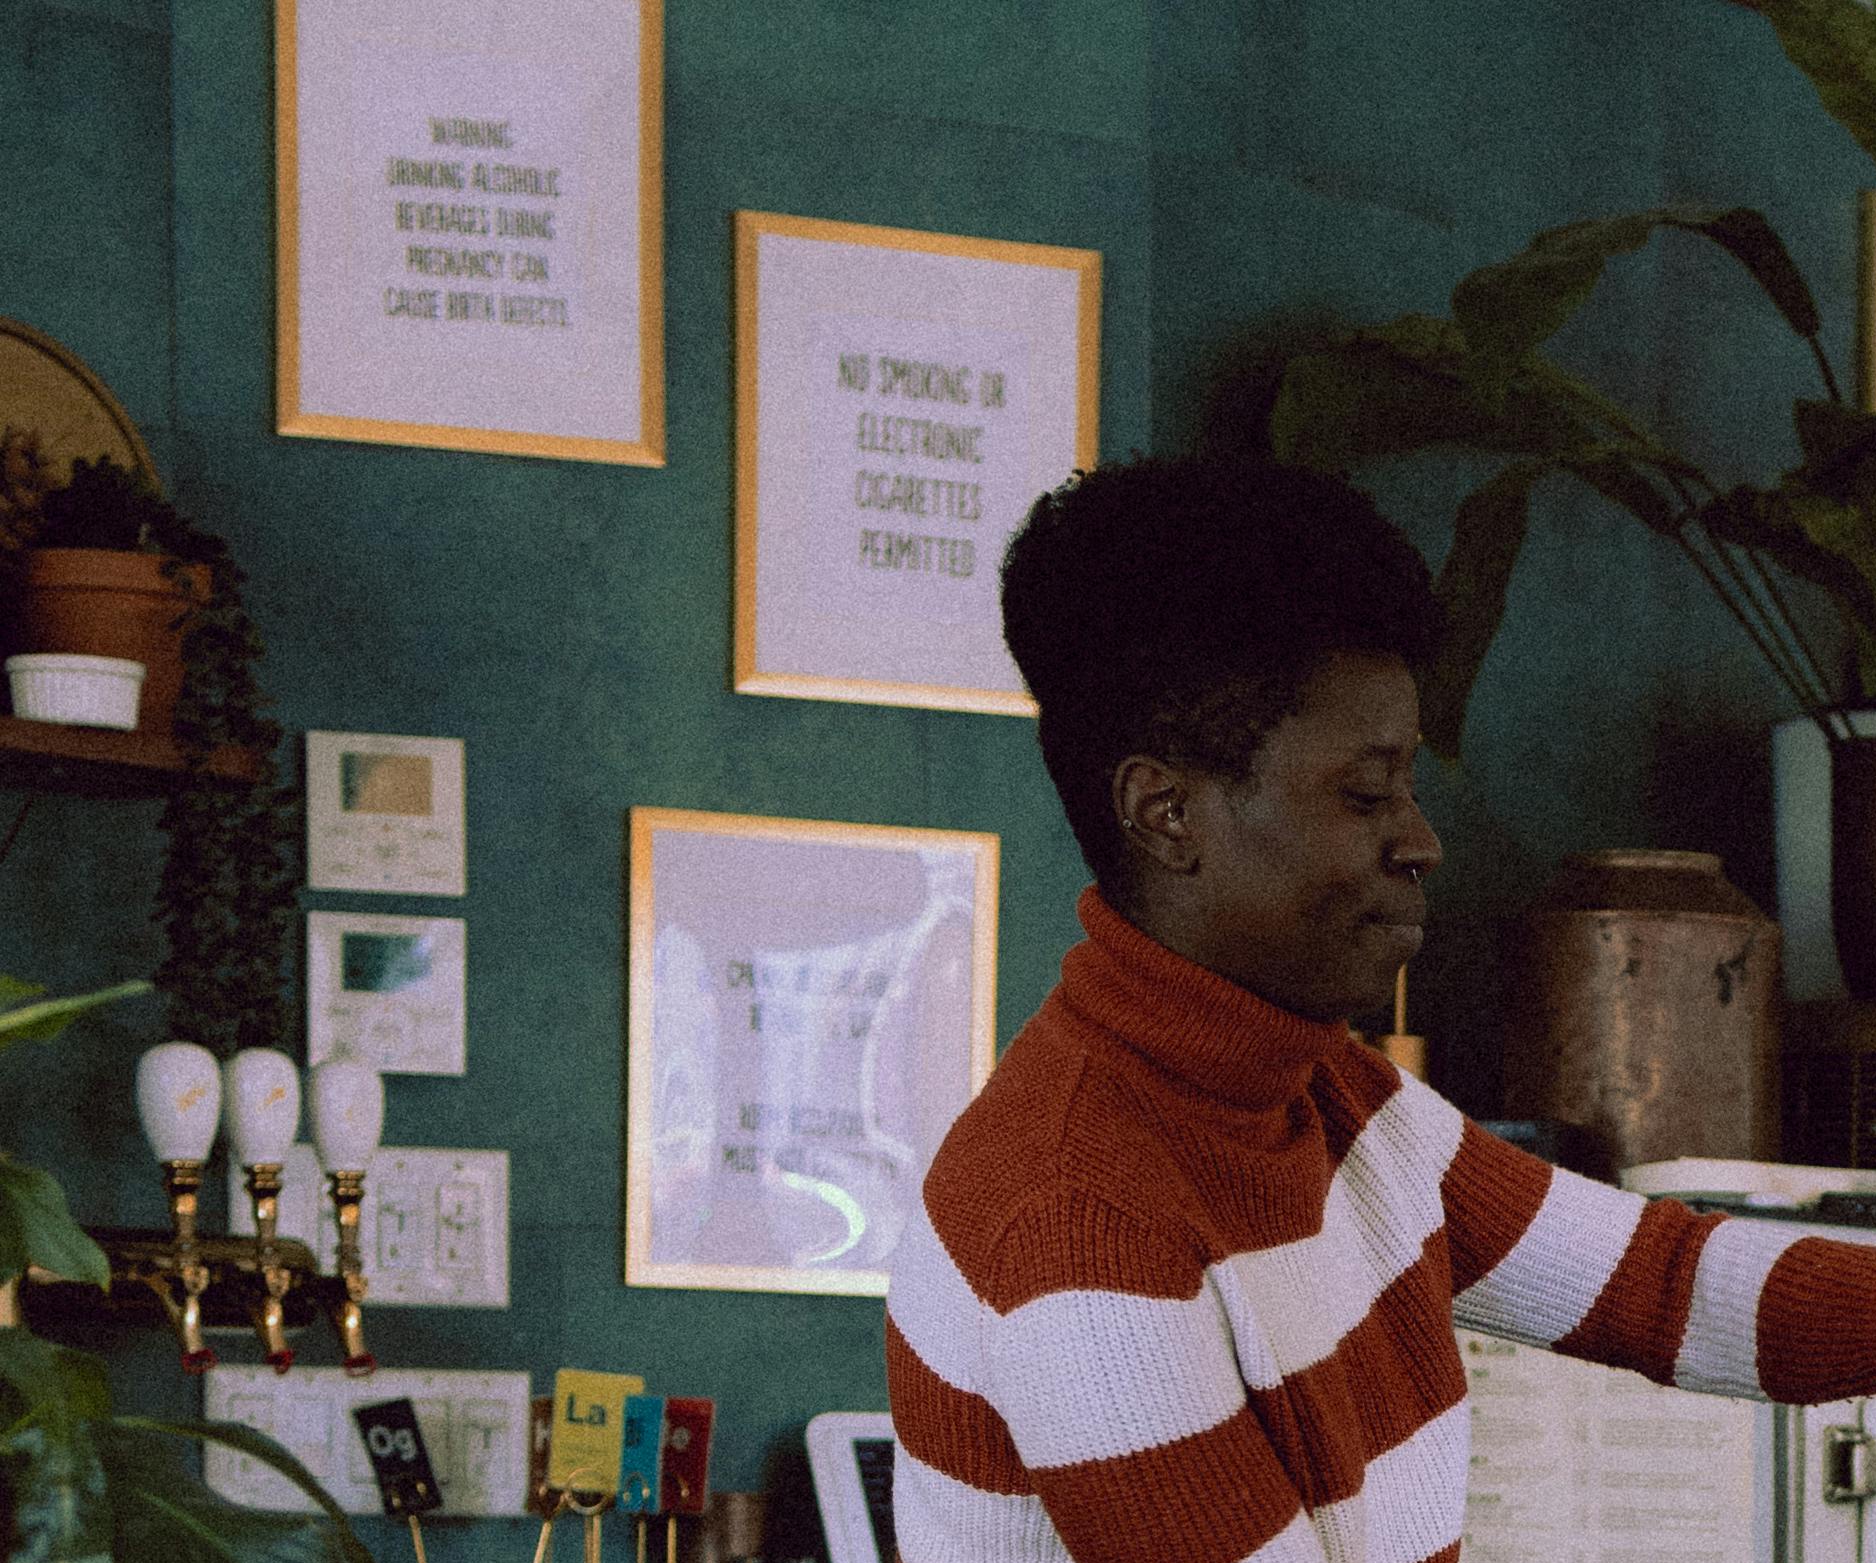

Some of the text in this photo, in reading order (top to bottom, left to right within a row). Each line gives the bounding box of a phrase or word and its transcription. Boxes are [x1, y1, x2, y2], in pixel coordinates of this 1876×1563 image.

[837, 352, 1006, 409] NO SMOKING OR
[856, 412, 984, 464] ELECTRONIC
[855, 469, 983, 523] CIGARETTES
[859, 528, 975, 578] PERMITTED
[567, 1394, 607, 1426] La
[368, 1425, 418, 1462] Og
